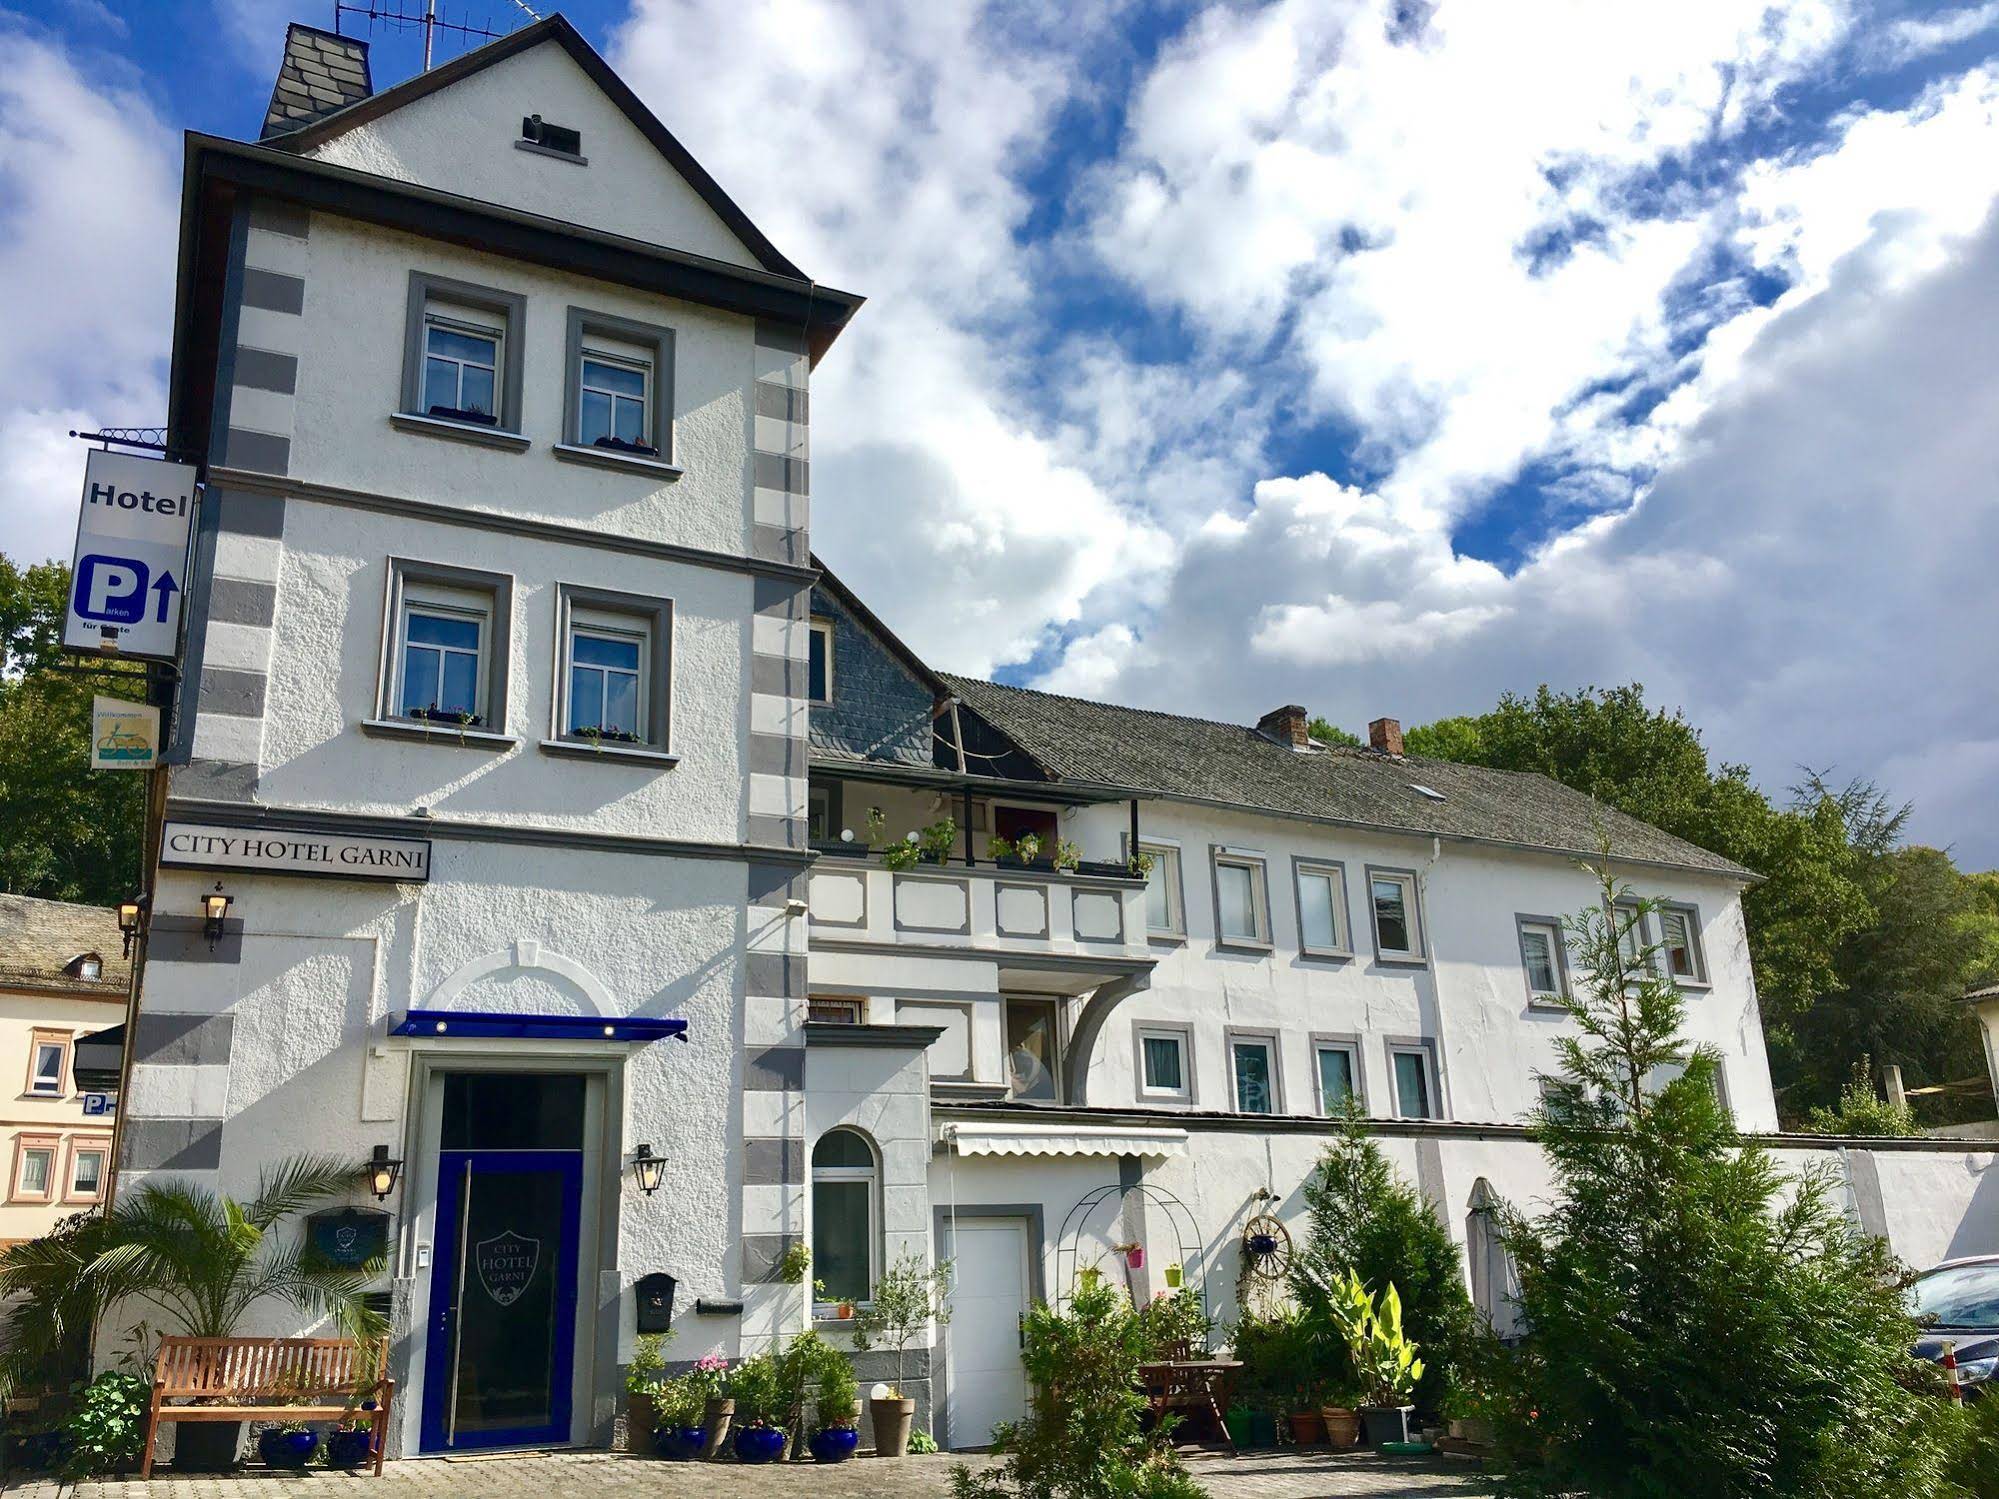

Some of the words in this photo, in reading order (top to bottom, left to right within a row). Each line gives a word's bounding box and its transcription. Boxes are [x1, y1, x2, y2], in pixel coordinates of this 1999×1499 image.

[89, 482, 187, 517] Hotel
[170, 834, 238, 856] CITY
[241, 839, 333, 864] HOTEL
[340, 846, 424, 869] GARNI
[86, 1095, 102, 1113] P
[494, 1244, 521, 1254] CITY
[482, 1256, 533, 1270] HOTEL
[489, 1272, 525, 1282] GARNI
